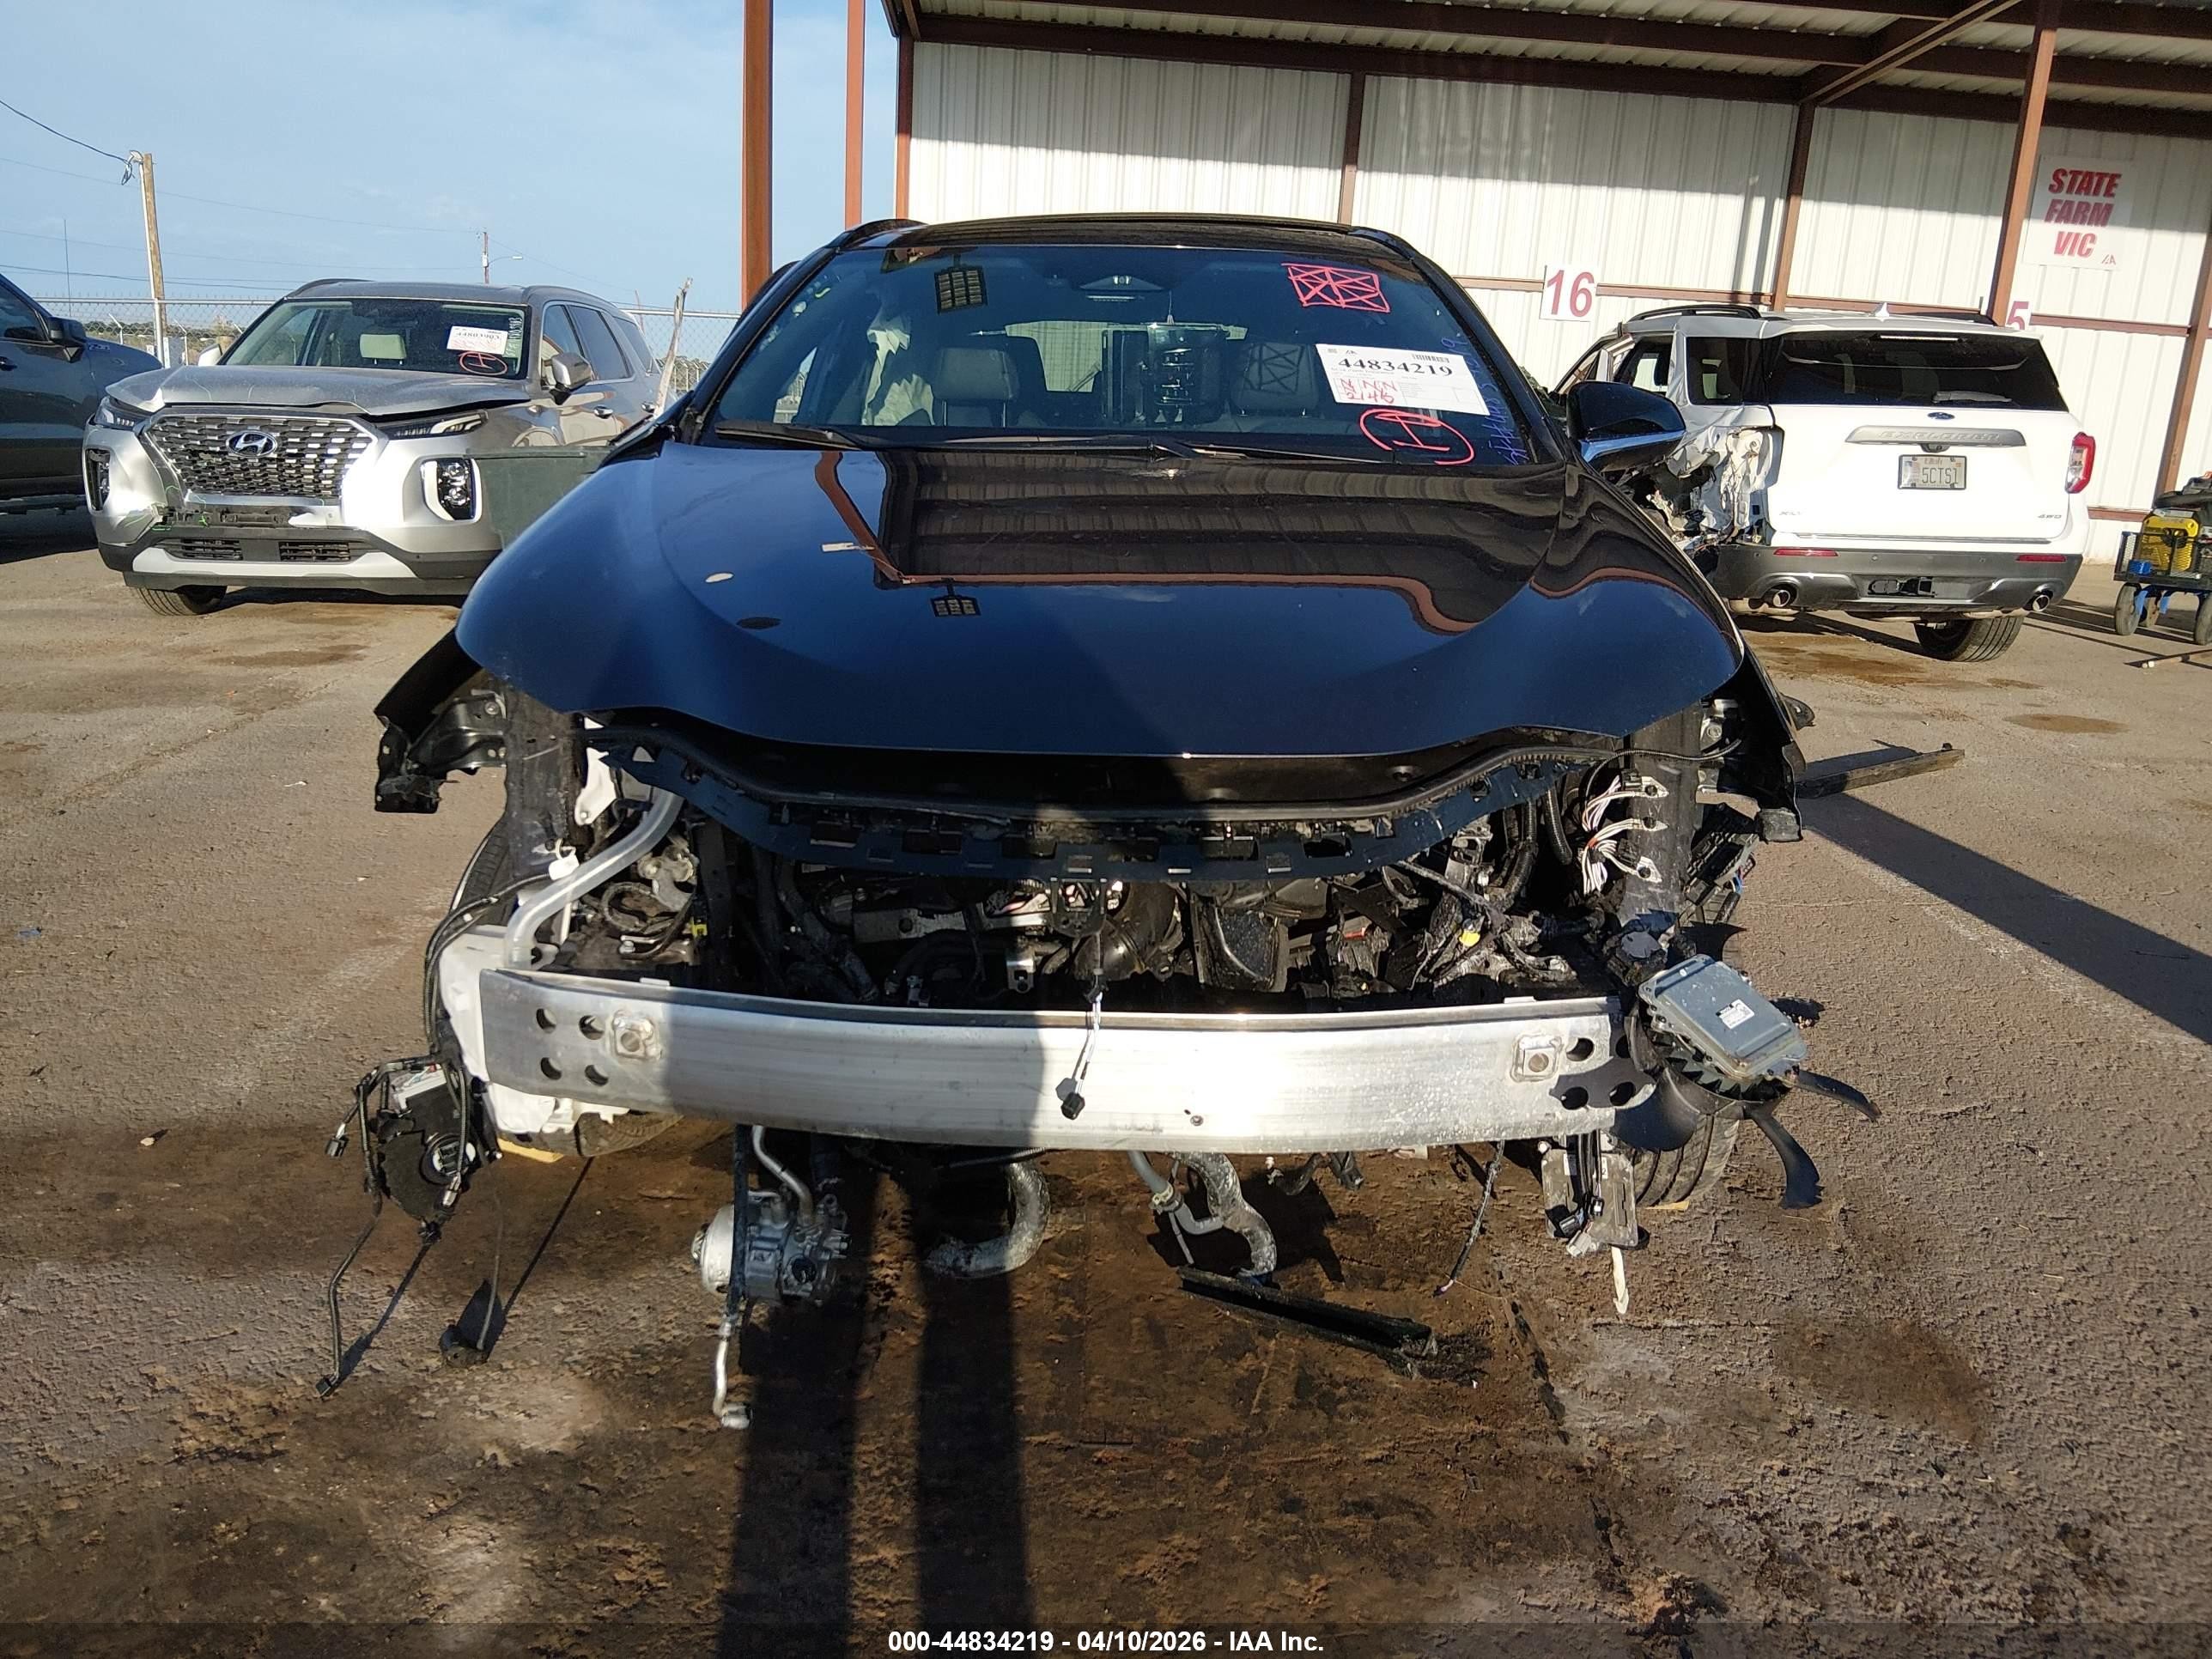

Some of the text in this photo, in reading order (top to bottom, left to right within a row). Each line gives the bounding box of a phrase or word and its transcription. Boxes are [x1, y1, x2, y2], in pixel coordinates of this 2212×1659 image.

[2048, 167, 2123, 198] STATE
[2044, 199, 2114, 228] FARM
[2053, 230, 2098, 258] VIC
[1547, 269, 1595, 318] 16
[1339, 357, 1453, 376] 44834219
